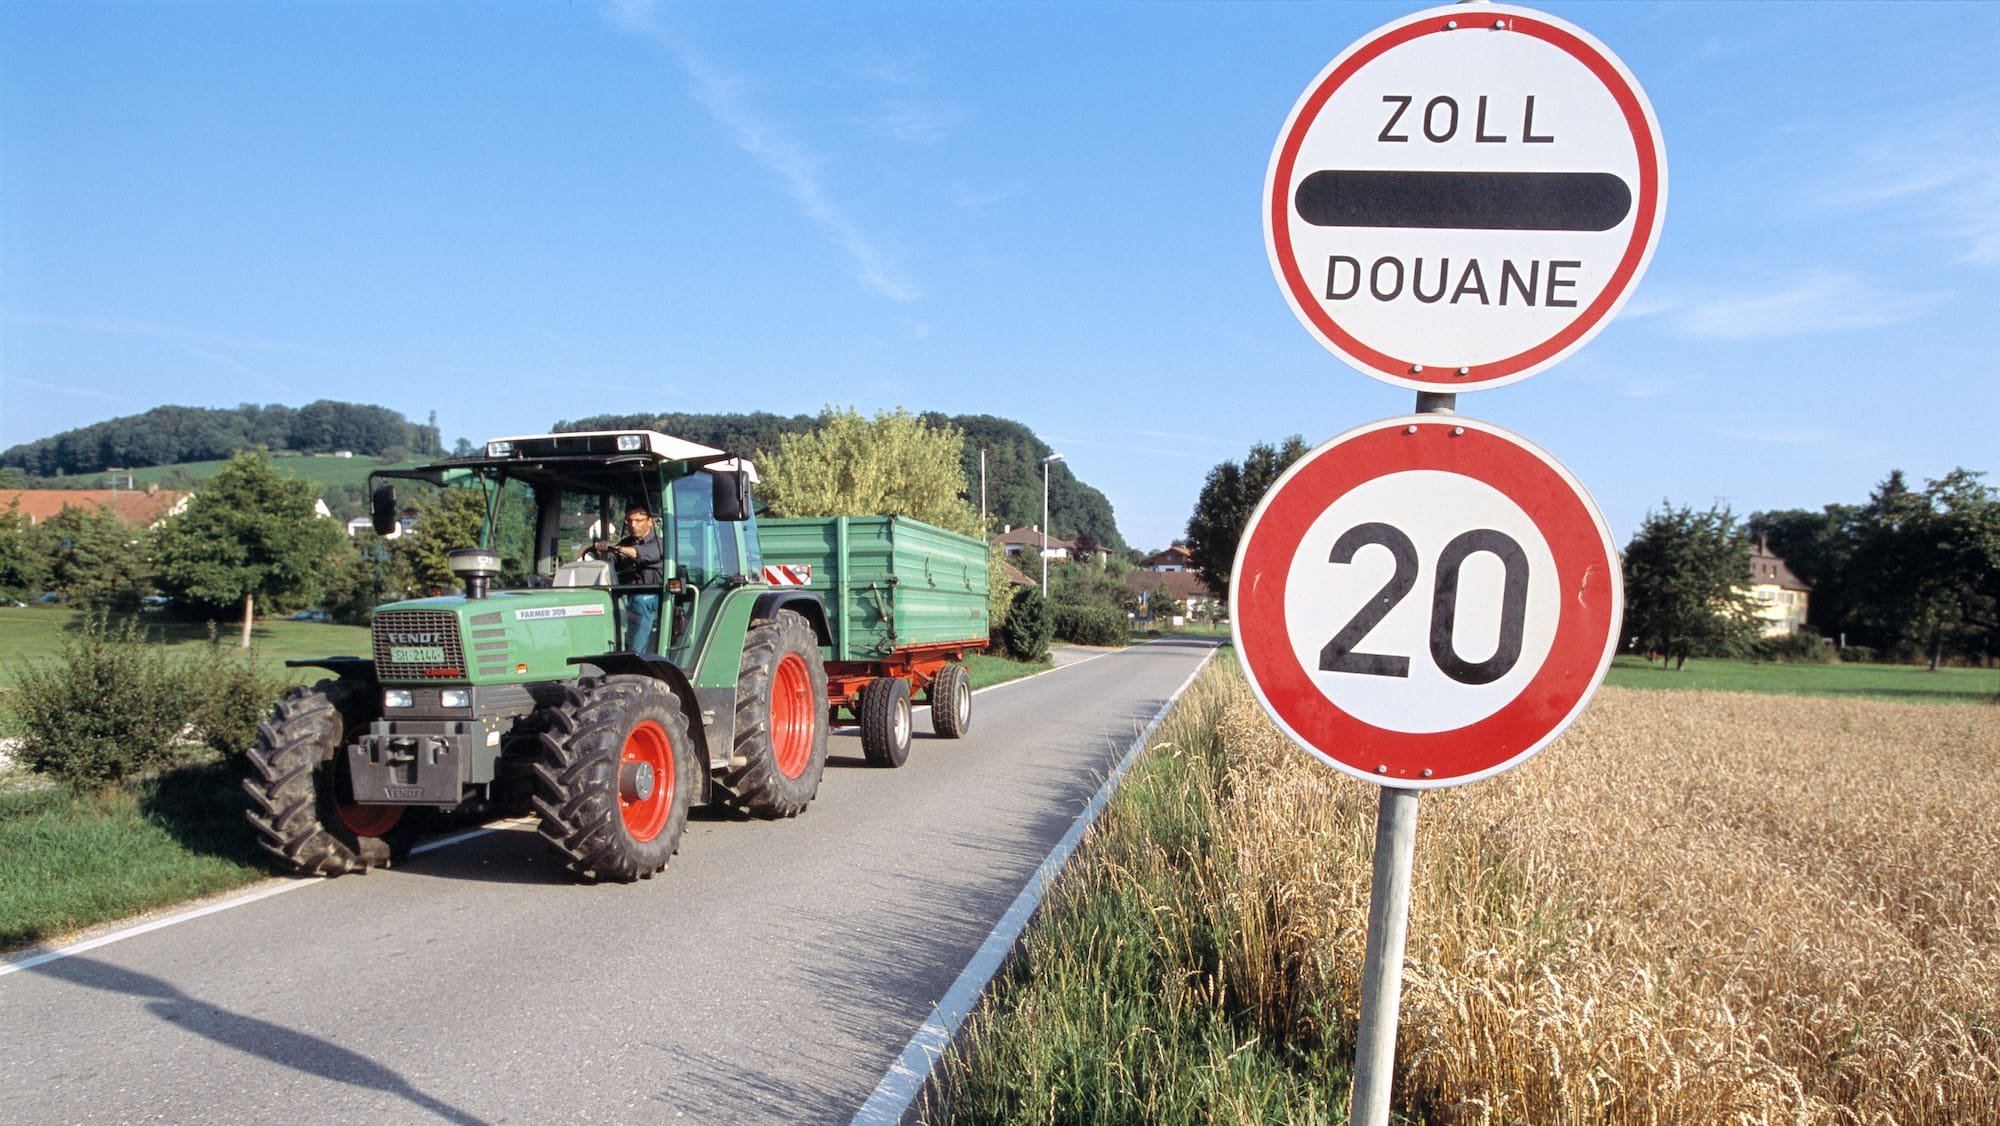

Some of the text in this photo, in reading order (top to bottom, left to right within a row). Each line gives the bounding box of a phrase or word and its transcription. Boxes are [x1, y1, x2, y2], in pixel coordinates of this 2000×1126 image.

[1377, 95, 1555, 144] ZOLL
[1325, 255, 1582, 308] DOUANE
[520, 610, 550, 618] FARMER
[1318, 521, 1530, 686] 20
[388, 632, 440, 643] FENDT
